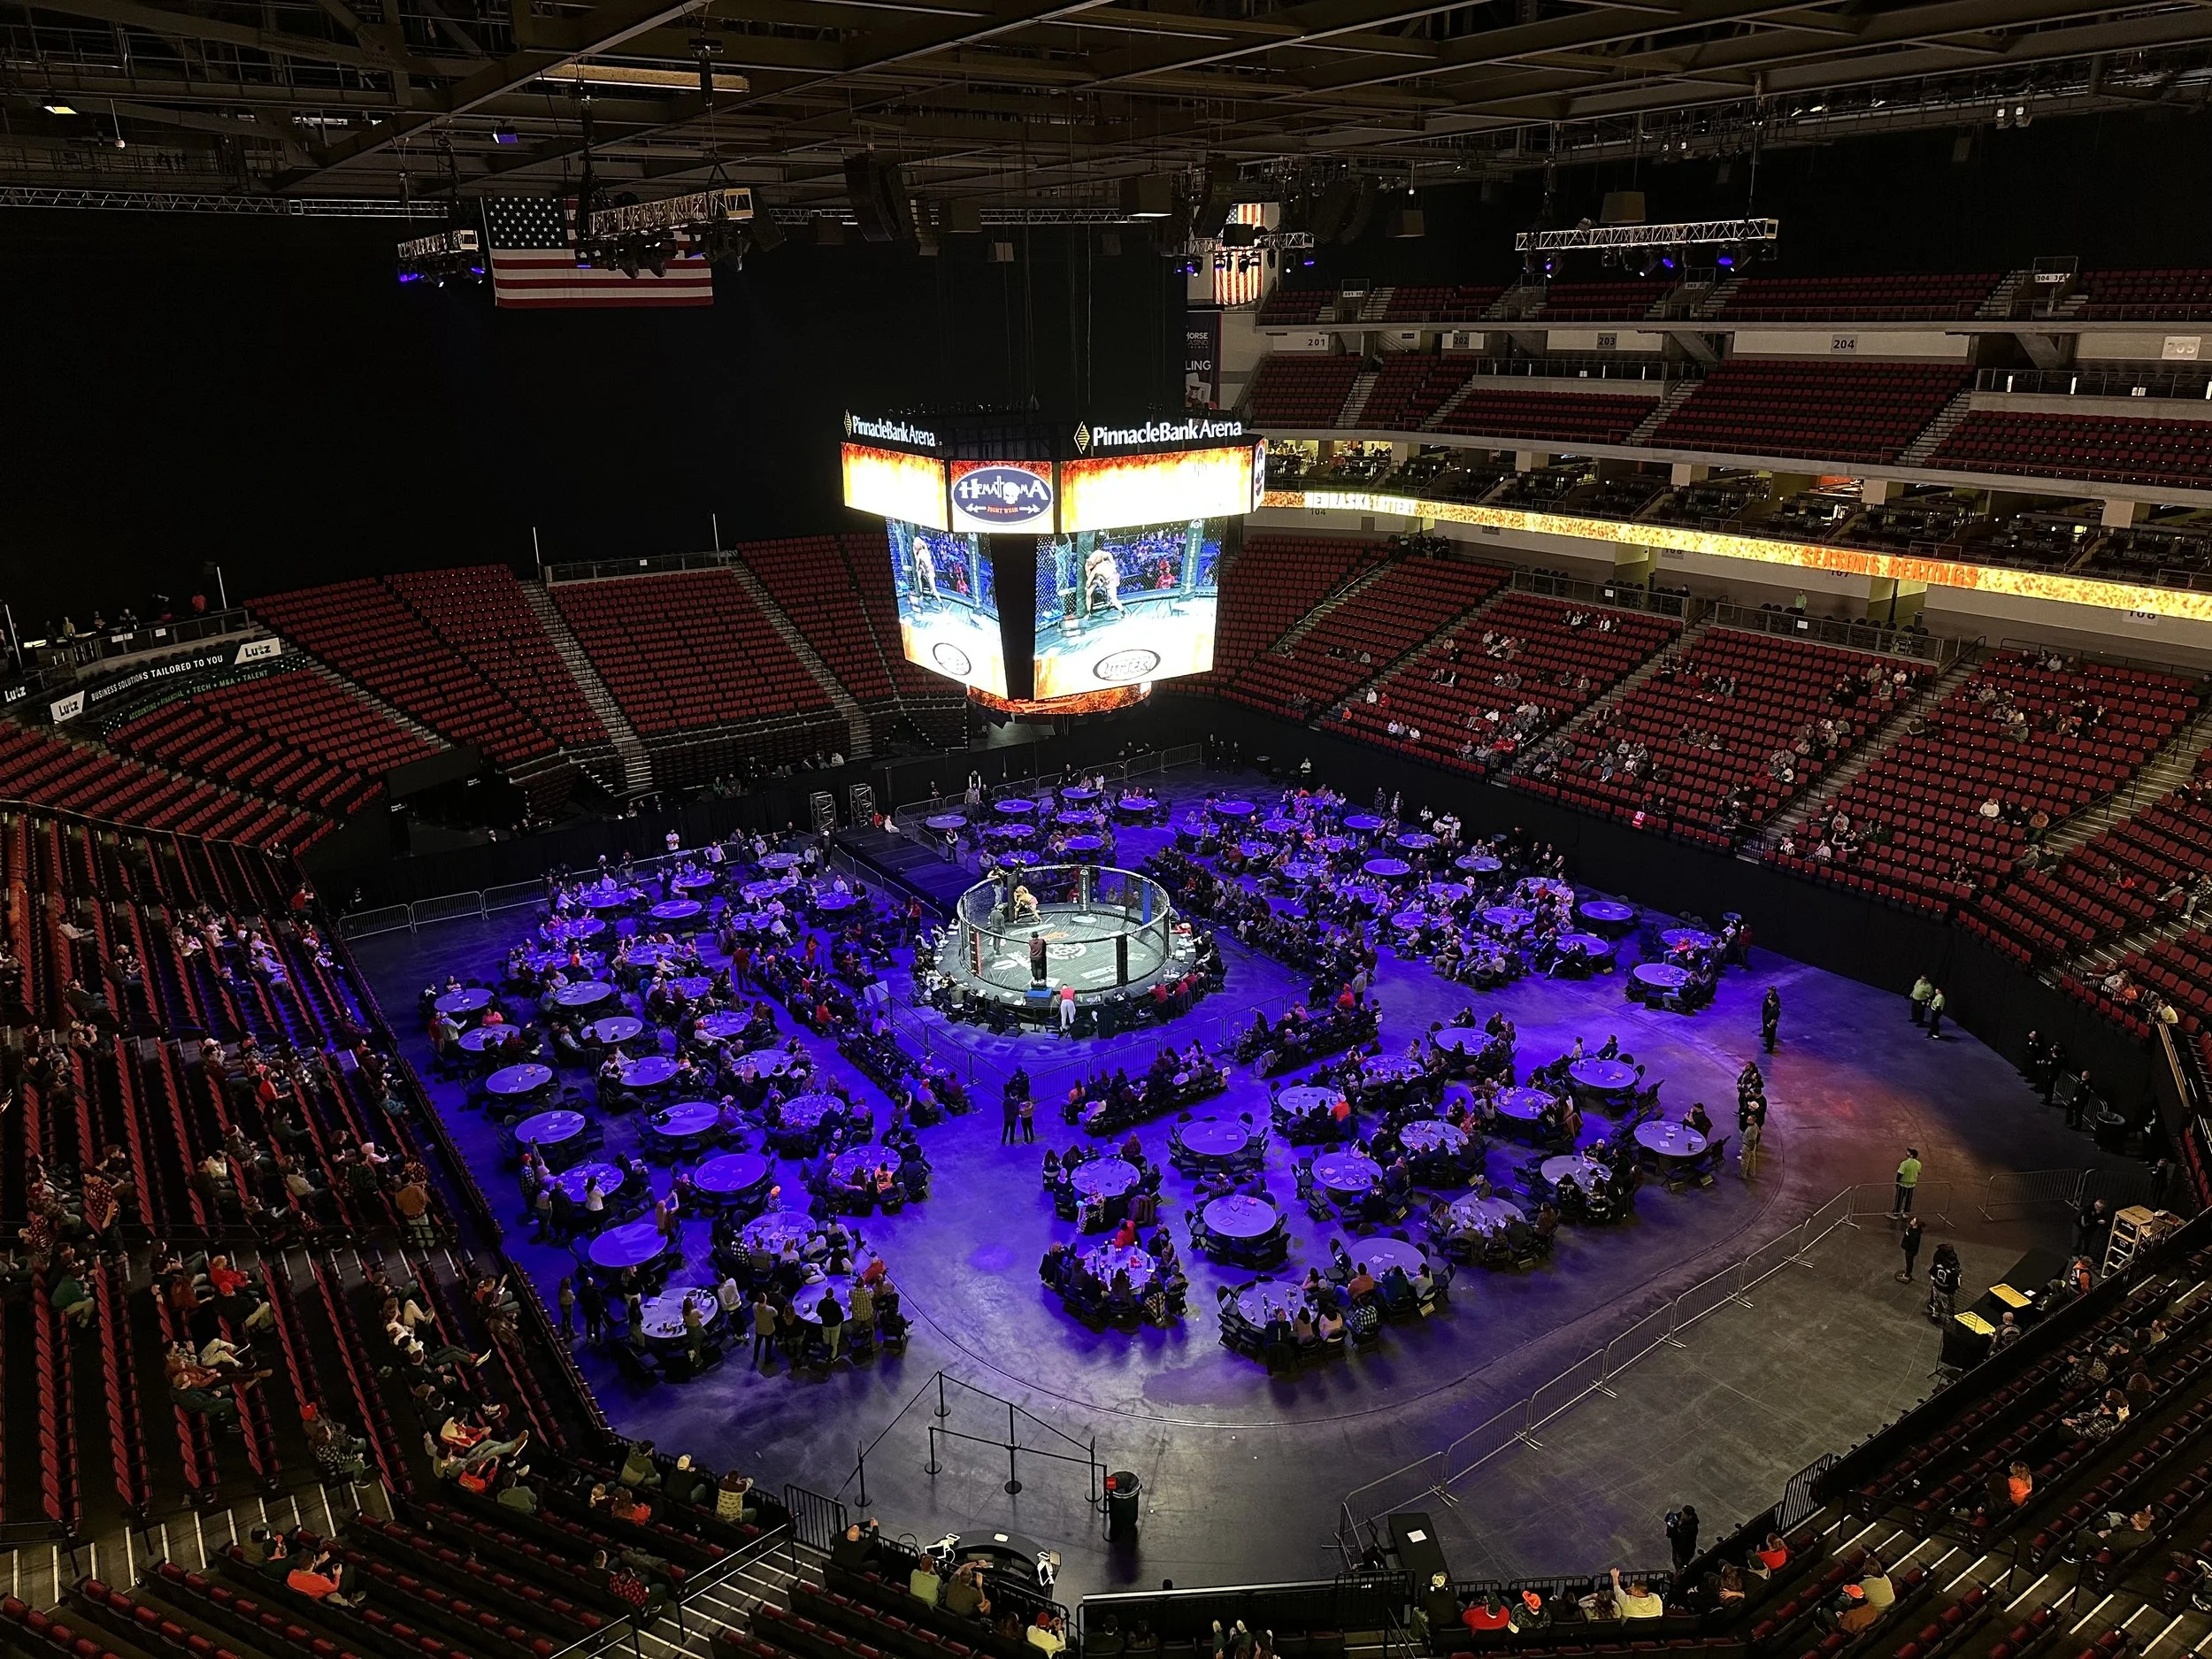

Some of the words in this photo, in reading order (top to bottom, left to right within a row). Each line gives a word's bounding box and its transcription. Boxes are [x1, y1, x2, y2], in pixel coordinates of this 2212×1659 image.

[1599, 336, 1615, 345] 203
[1833, 340, 1855, 349] 204
[909, 424, 935, 447] Arena
[1198, 419, 1242, 440] Arena
[1801, 547, 1881, 575] SEASONS
[1887, 555, 1978, 588] BEATINGS
[245, 643, 272, 658] Lutz
[90, 683, 118, 702] BUSINESS
[118, 671, 149, 688] SOLUTIONS
[150, 661, 192, 679] TAILORED
[192, 658, 205, 670] TO
[205, 654, 224, 665] YOU
[192, 684, 211, 694] TECH
[219, 678, 235, 687] M&A
[242, 670, 269, 681] TALENT
